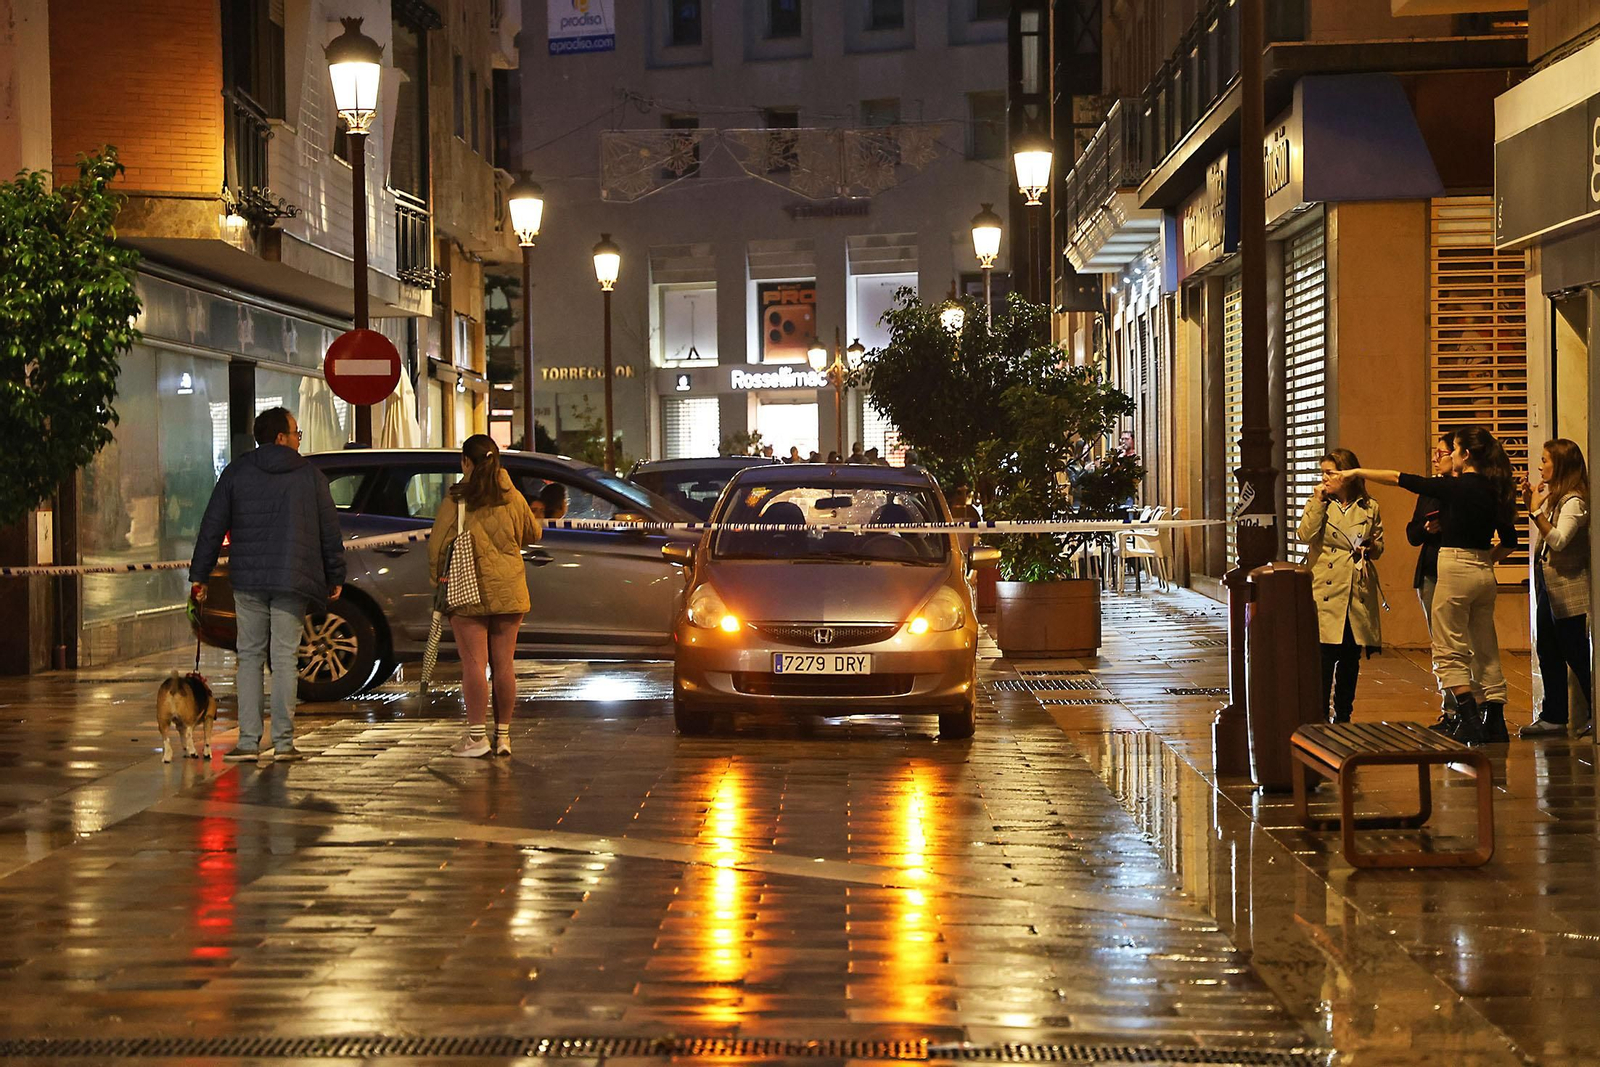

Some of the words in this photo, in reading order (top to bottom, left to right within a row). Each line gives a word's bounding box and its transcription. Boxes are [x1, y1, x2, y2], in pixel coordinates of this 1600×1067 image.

[560, 12, 602, 31] prodisa
[550, 37, 614, 53] eprodisa.com
[540, 365, 635, 381] TORRECOON
[784, 655, 826, 673] 7279
[834, 656, 866, 673] DRY
